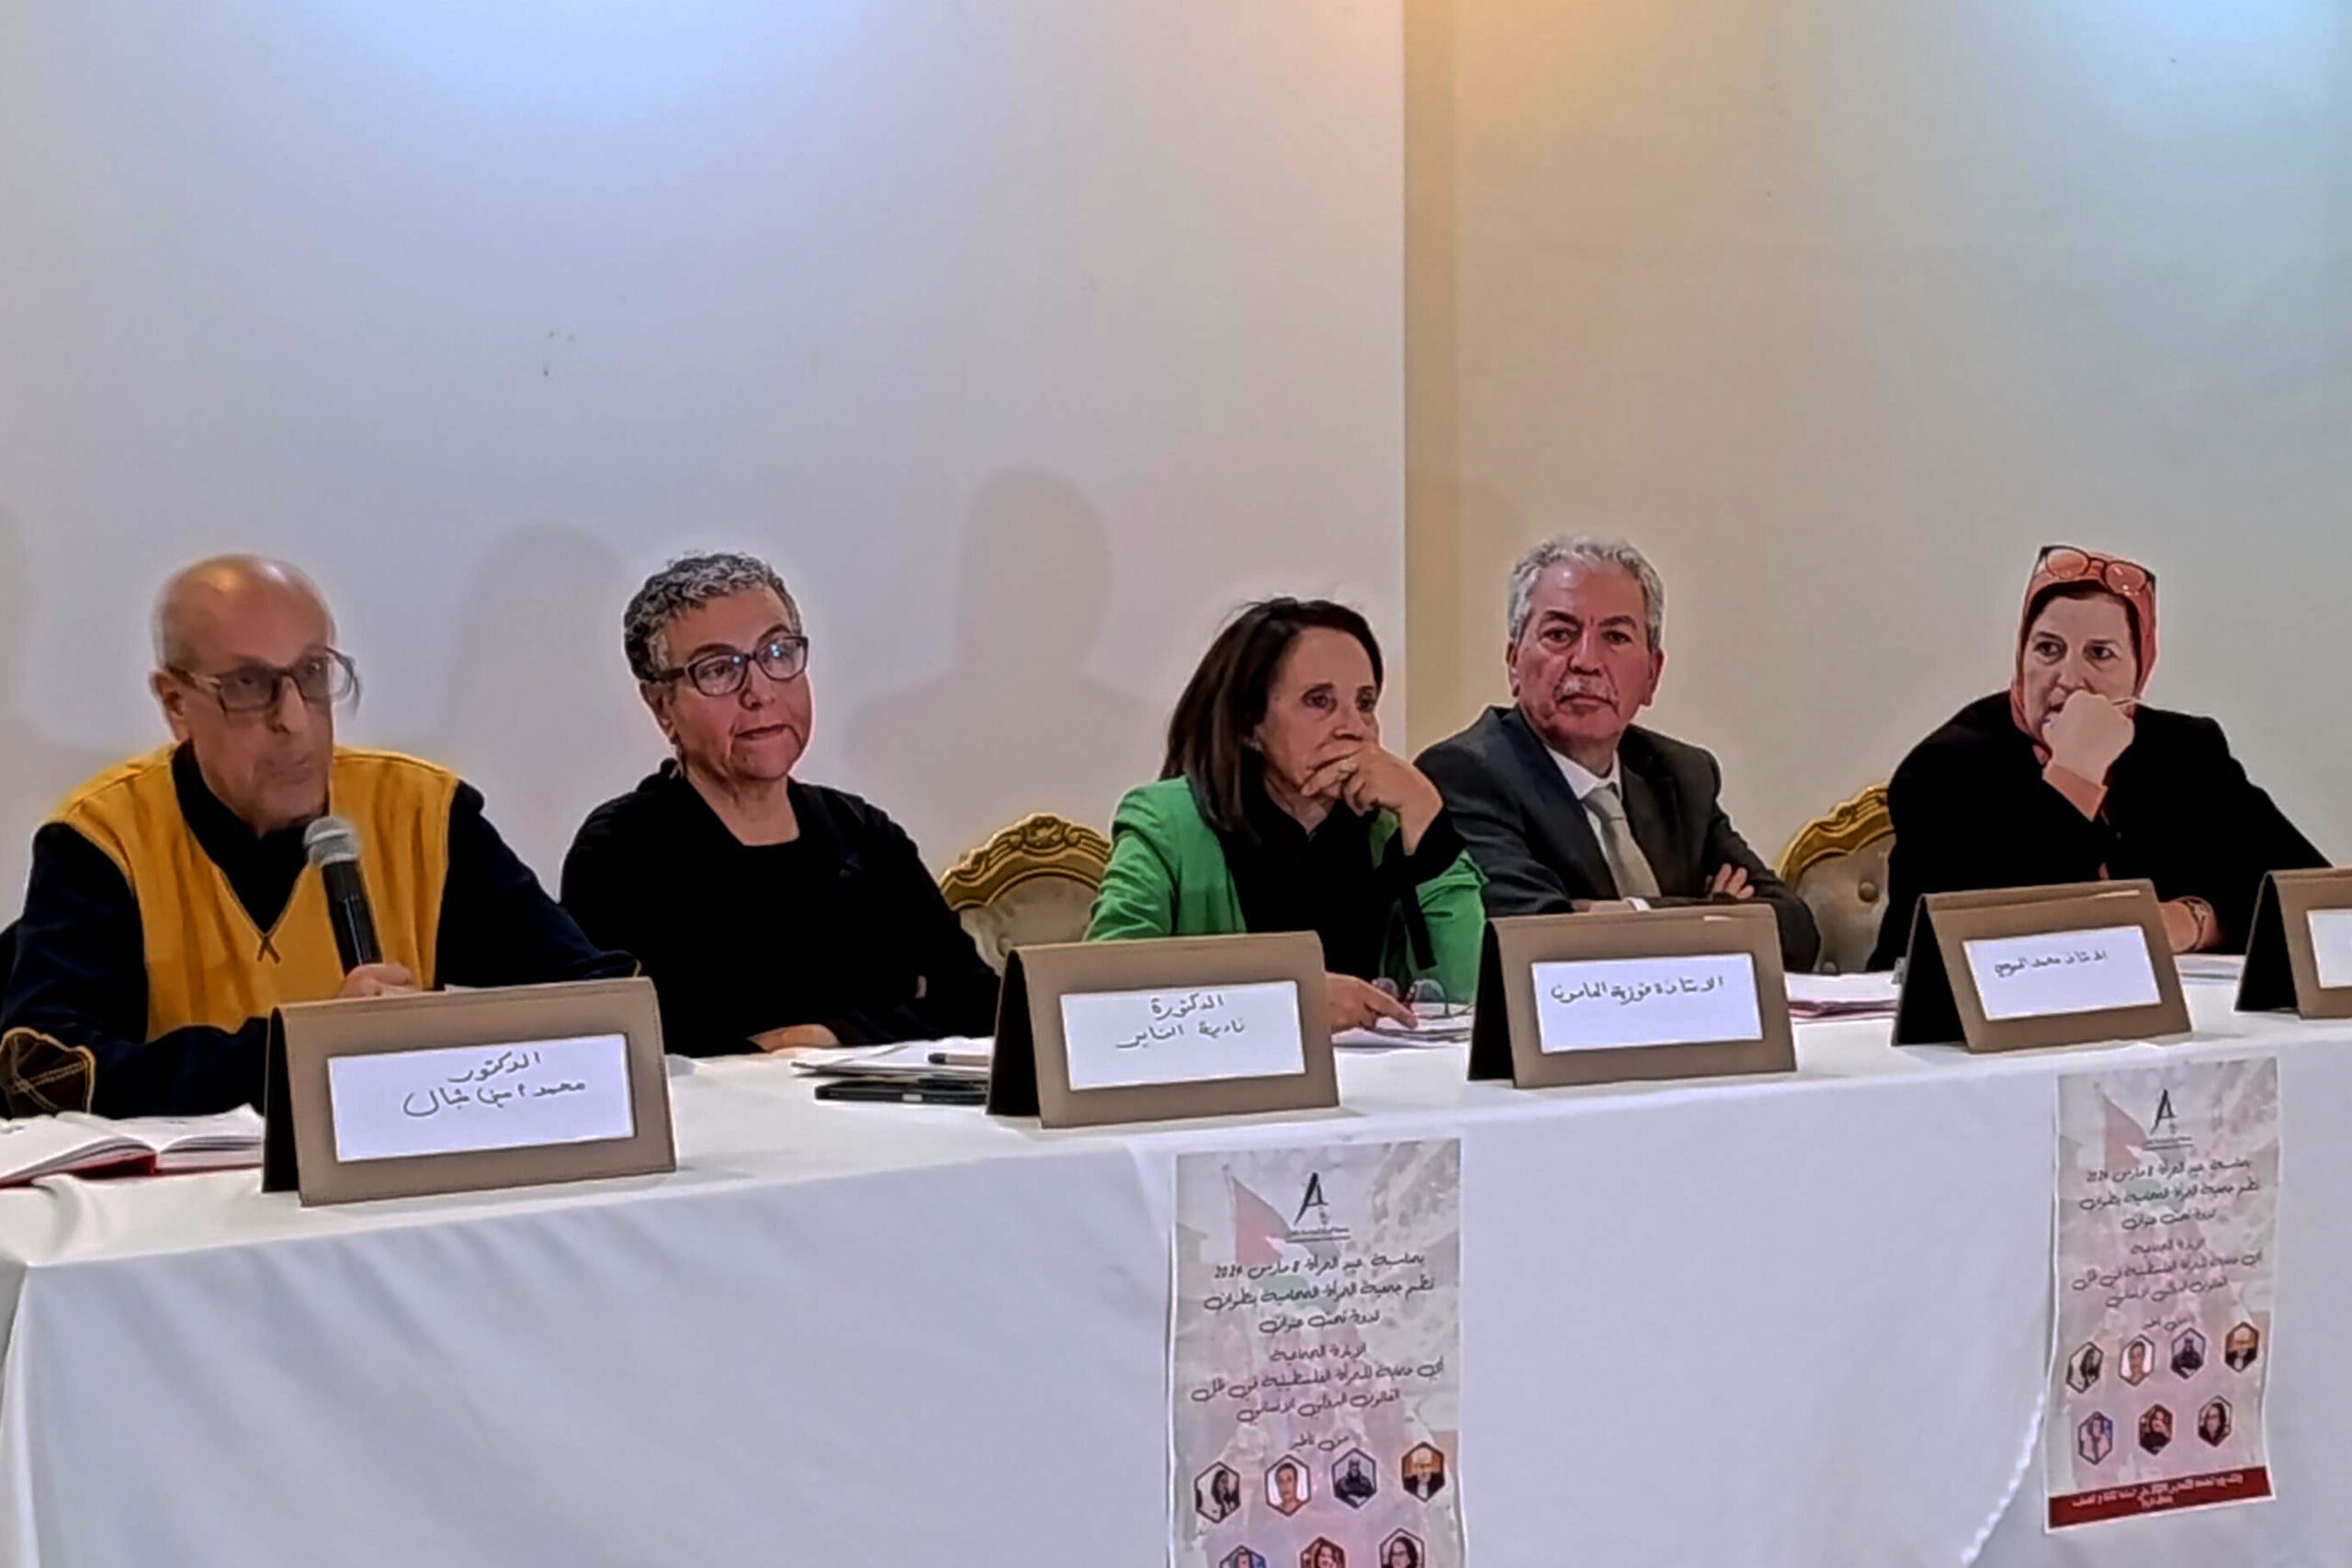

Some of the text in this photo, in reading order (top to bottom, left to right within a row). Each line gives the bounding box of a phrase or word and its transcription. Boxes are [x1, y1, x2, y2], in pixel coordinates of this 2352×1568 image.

[1610, 982, 1652, 1006] فوزية
[1150, 993, 1224, 1021] الدكتورة
[1198, 1018, 1245, 1039] نادية
[447, 1051, 541, 1083] الدكتور
[533, 1081, 586, 1098] محمد
[1248, 1259, 1290, 1280] مارس
[1306, 1253, 1338, 1276] المرأة
[1342, 1258, 1363, 1273] عيد
[1370, 1253, 1425, 1268] بمناسبة
[1361, 1279, 1402, 1297] جمعية
[1259, 1315, 1303, 1334] عنوان
[1307, 1310, 1347, 1327] تحت
[1191, 1379, 1226, 1402] ظل
[1227, 1379, 1259, 1401] في
